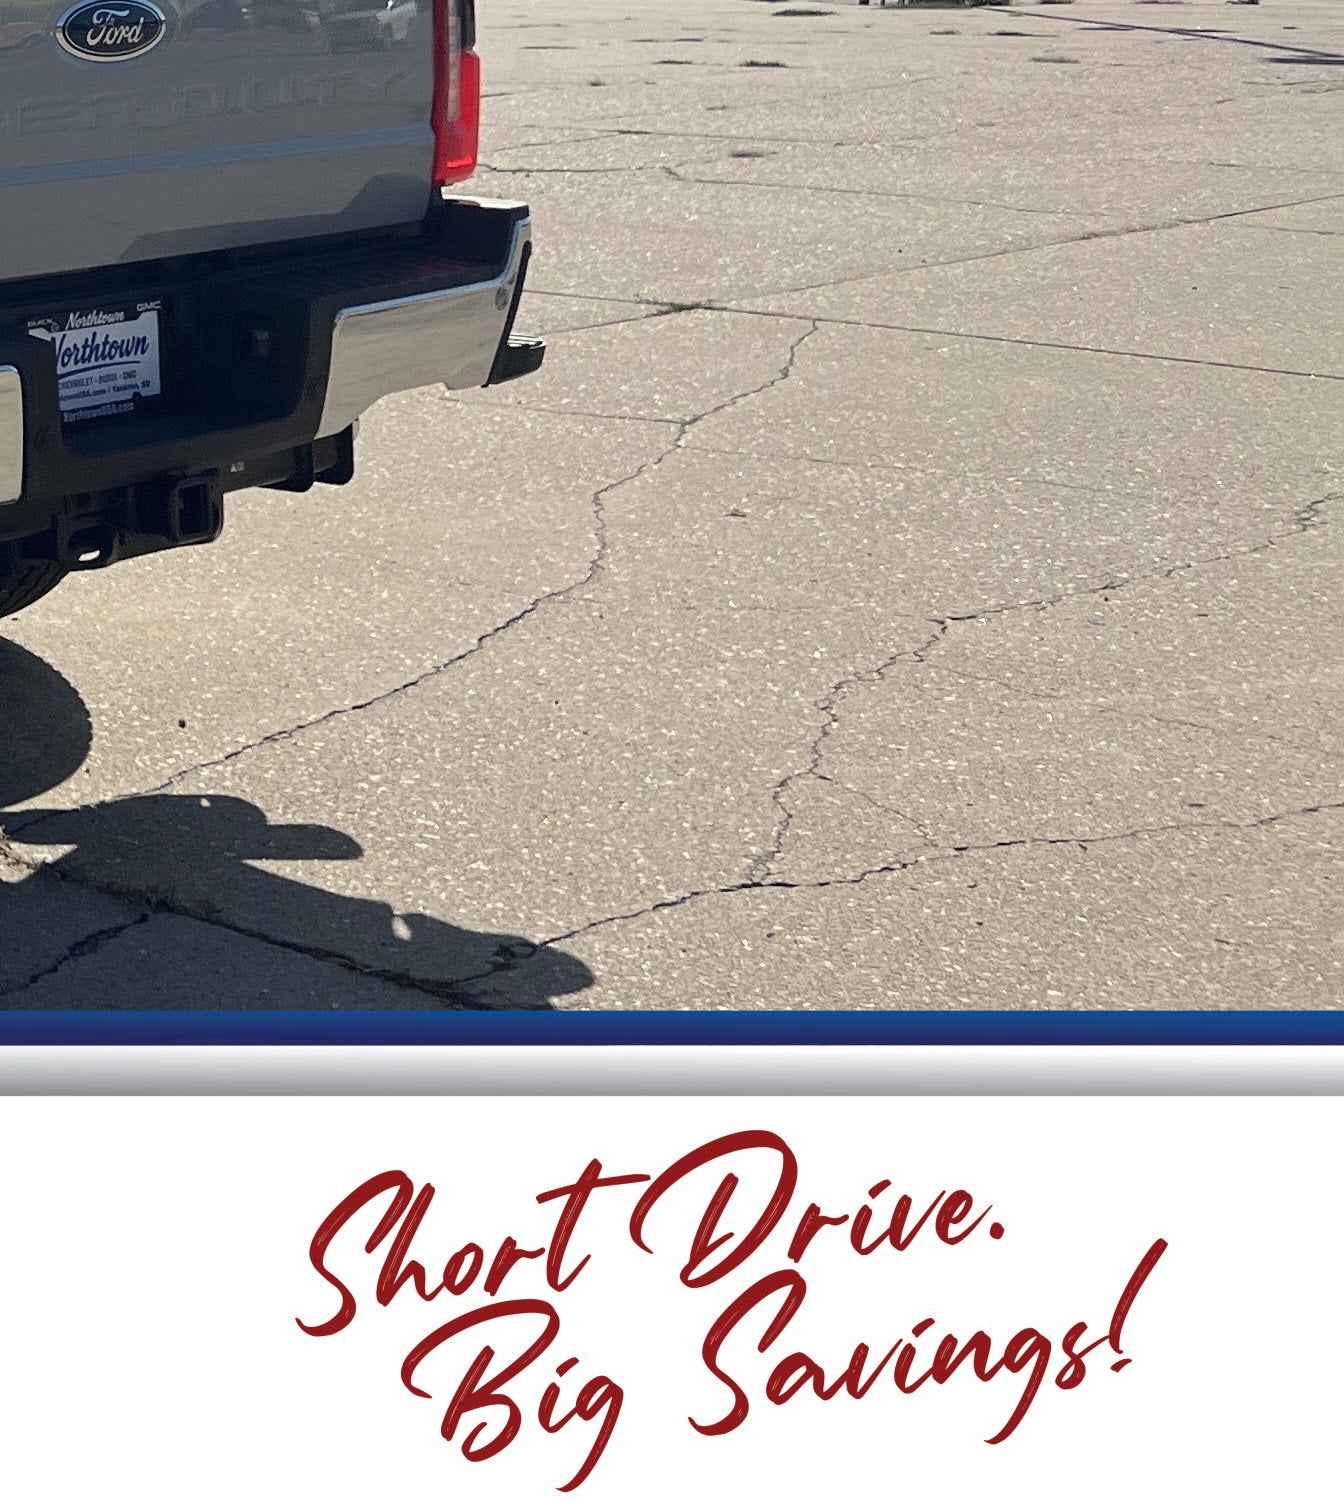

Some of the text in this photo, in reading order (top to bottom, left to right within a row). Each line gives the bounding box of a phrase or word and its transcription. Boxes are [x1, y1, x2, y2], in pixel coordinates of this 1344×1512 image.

[86, 9, 145, 46] Ford
[65, 309, 125, 330] Northtown
[136, 300, 161, 312] GMC
